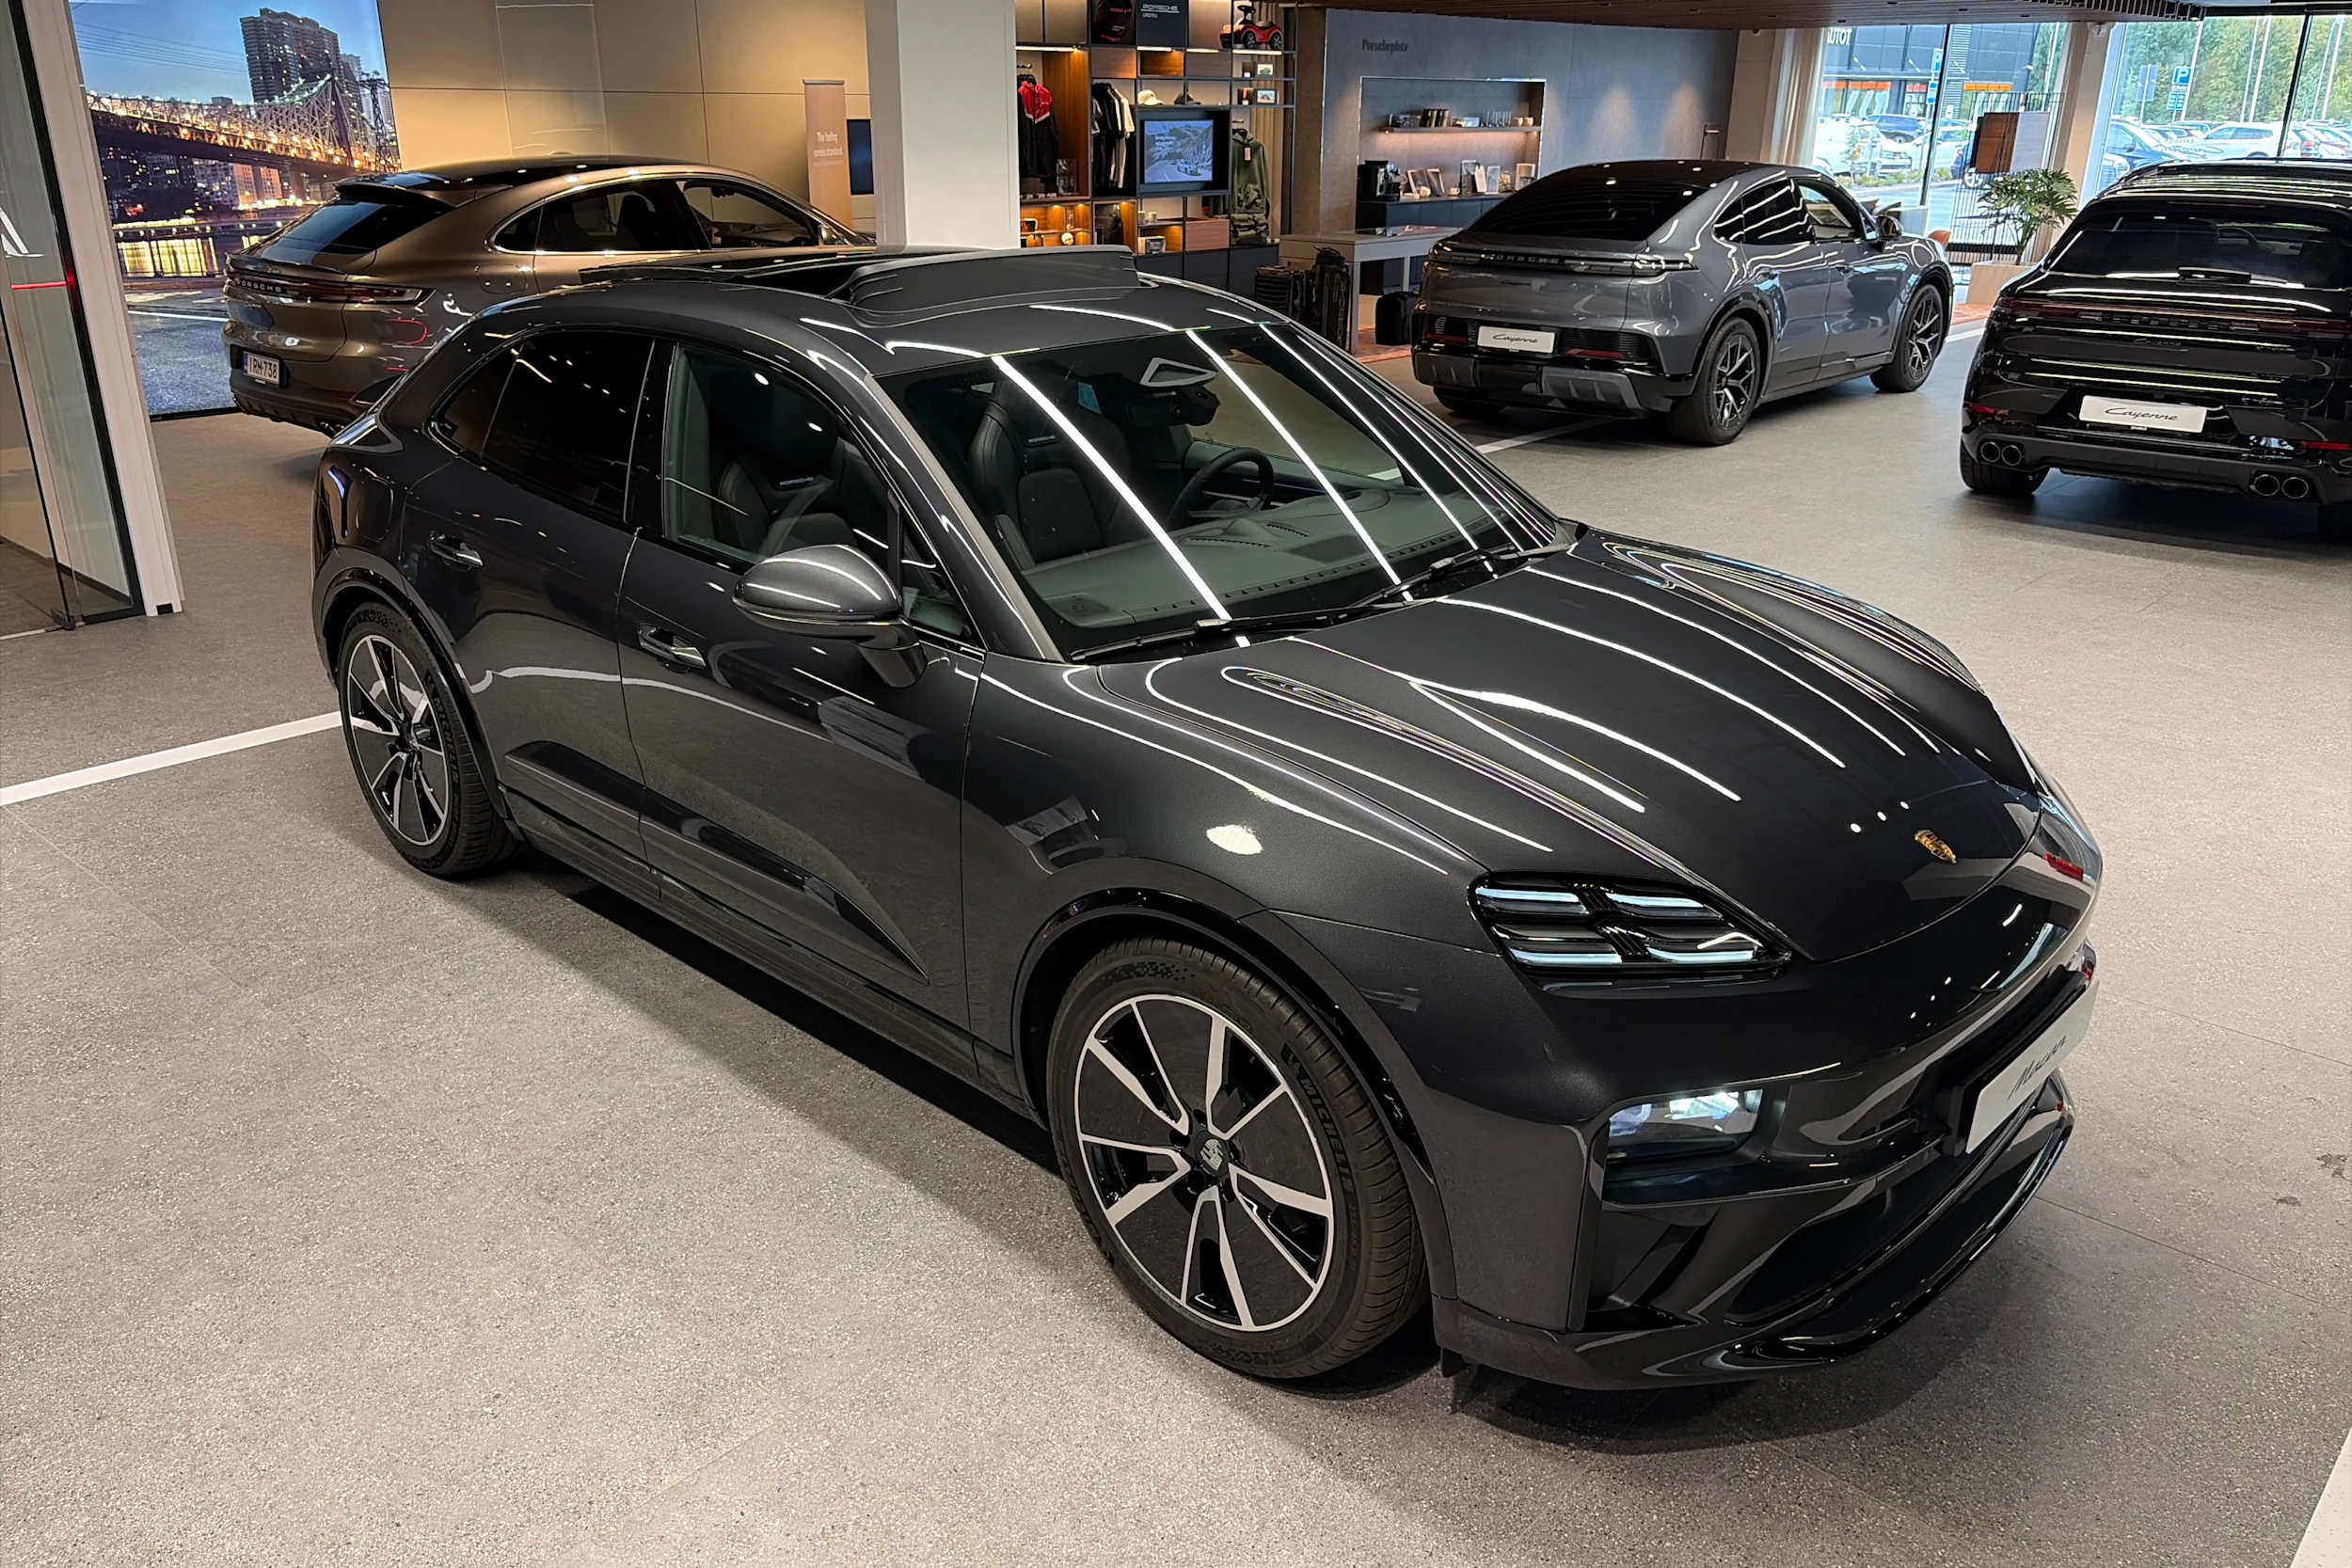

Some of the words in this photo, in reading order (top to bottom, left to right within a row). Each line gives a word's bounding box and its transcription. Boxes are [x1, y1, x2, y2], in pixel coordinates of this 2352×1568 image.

[2176, 69, 2190, 83] P
[1492, 334, 1538, 344] Cayenne
[2105, 407, 2179, 420] Cayenne
[433, 697, 460, 785] MICHELIN
[2007, 1036, 2066, 1101] Macan
[1300, 1079, 1356, 1196] MICHELIN
